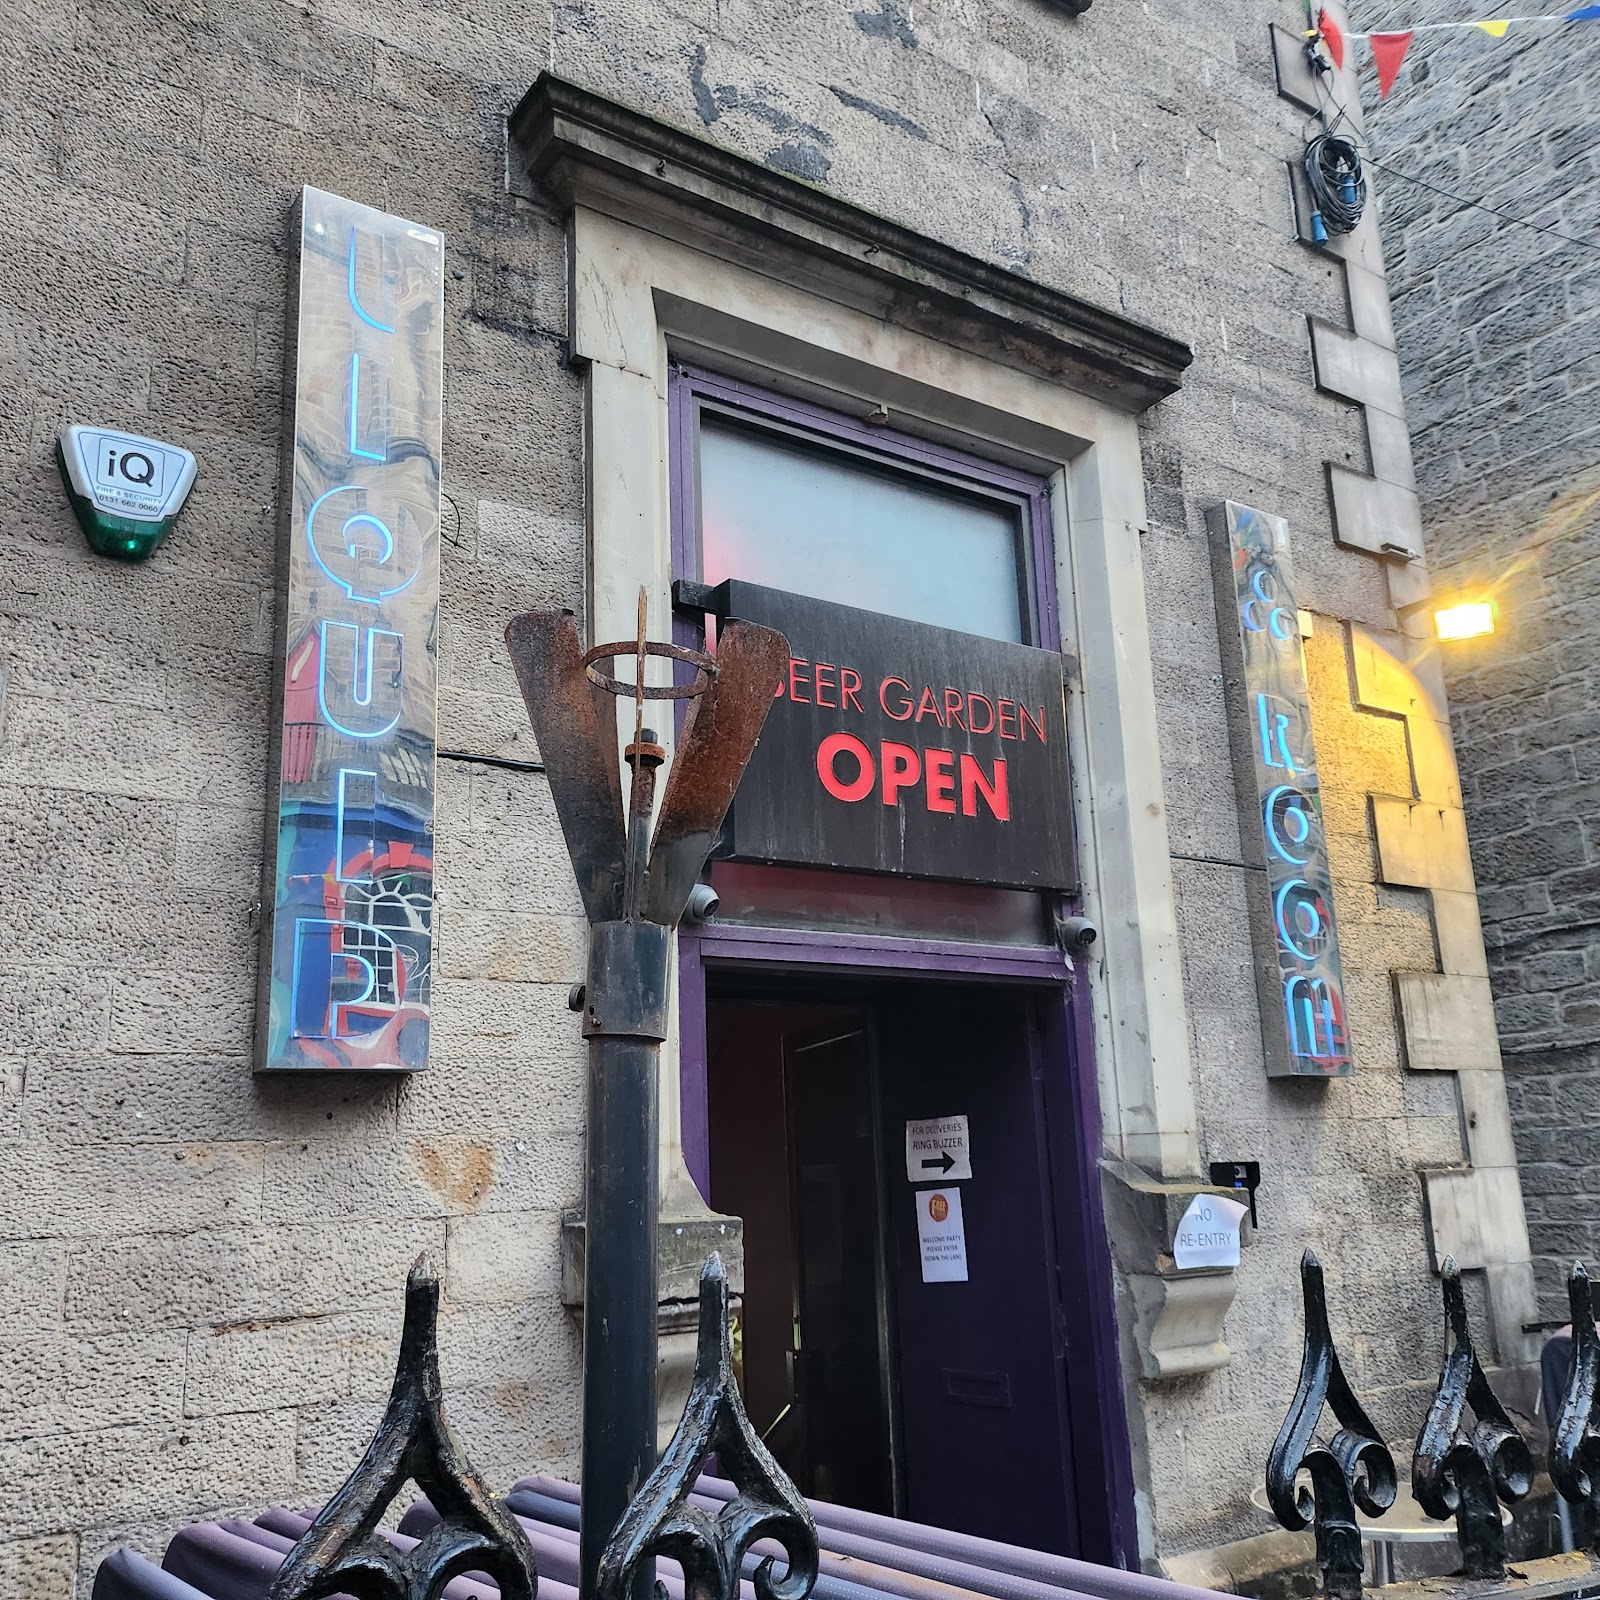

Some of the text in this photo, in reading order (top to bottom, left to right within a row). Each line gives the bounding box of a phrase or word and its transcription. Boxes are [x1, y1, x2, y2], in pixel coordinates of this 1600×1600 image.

[108, 450, 154, 488] iQ
[96, 486, 114, 495] FIRE
[124, 492, 162, 504] SECURITY
[99, 495, 159, 512] 0131 662 0060
[774, 657, 1048, 744] EER GARDEN
[816, 731, 1011, 821] OPEN
[1257, 693, 1344, 1057] ROOM
[912, 1123, 963, 1135] FOR DELIVERIES
[912, 1137, 963, 1151] RING BUZZER
[1195, 1208, 1212, 1221] NO
[1180, 1232, 1232, 1247] RE-ENTRY
